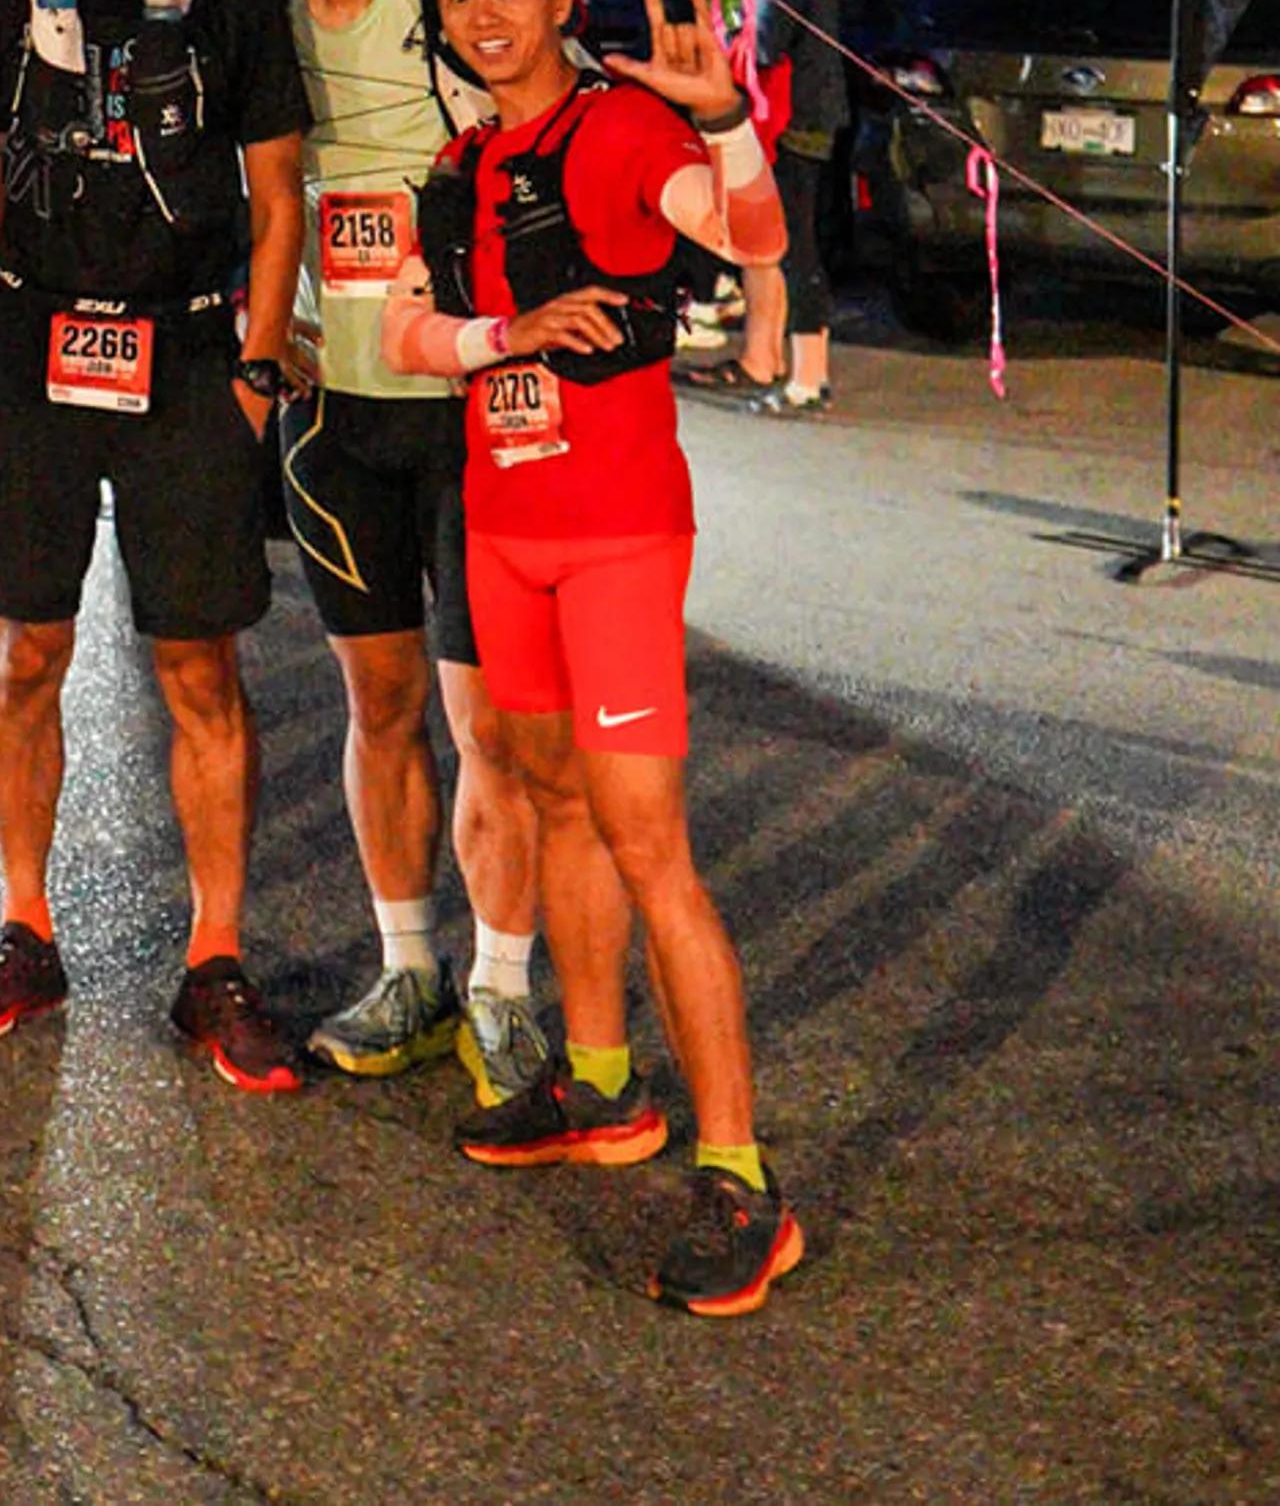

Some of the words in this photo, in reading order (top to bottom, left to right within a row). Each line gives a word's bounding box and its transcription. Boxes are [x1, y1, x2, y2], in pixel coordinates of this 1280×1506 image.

[330, 212, 395, 248] 2158
[61, 325, 139, 362] 2266
[486, 372, 541, 413] 2170
